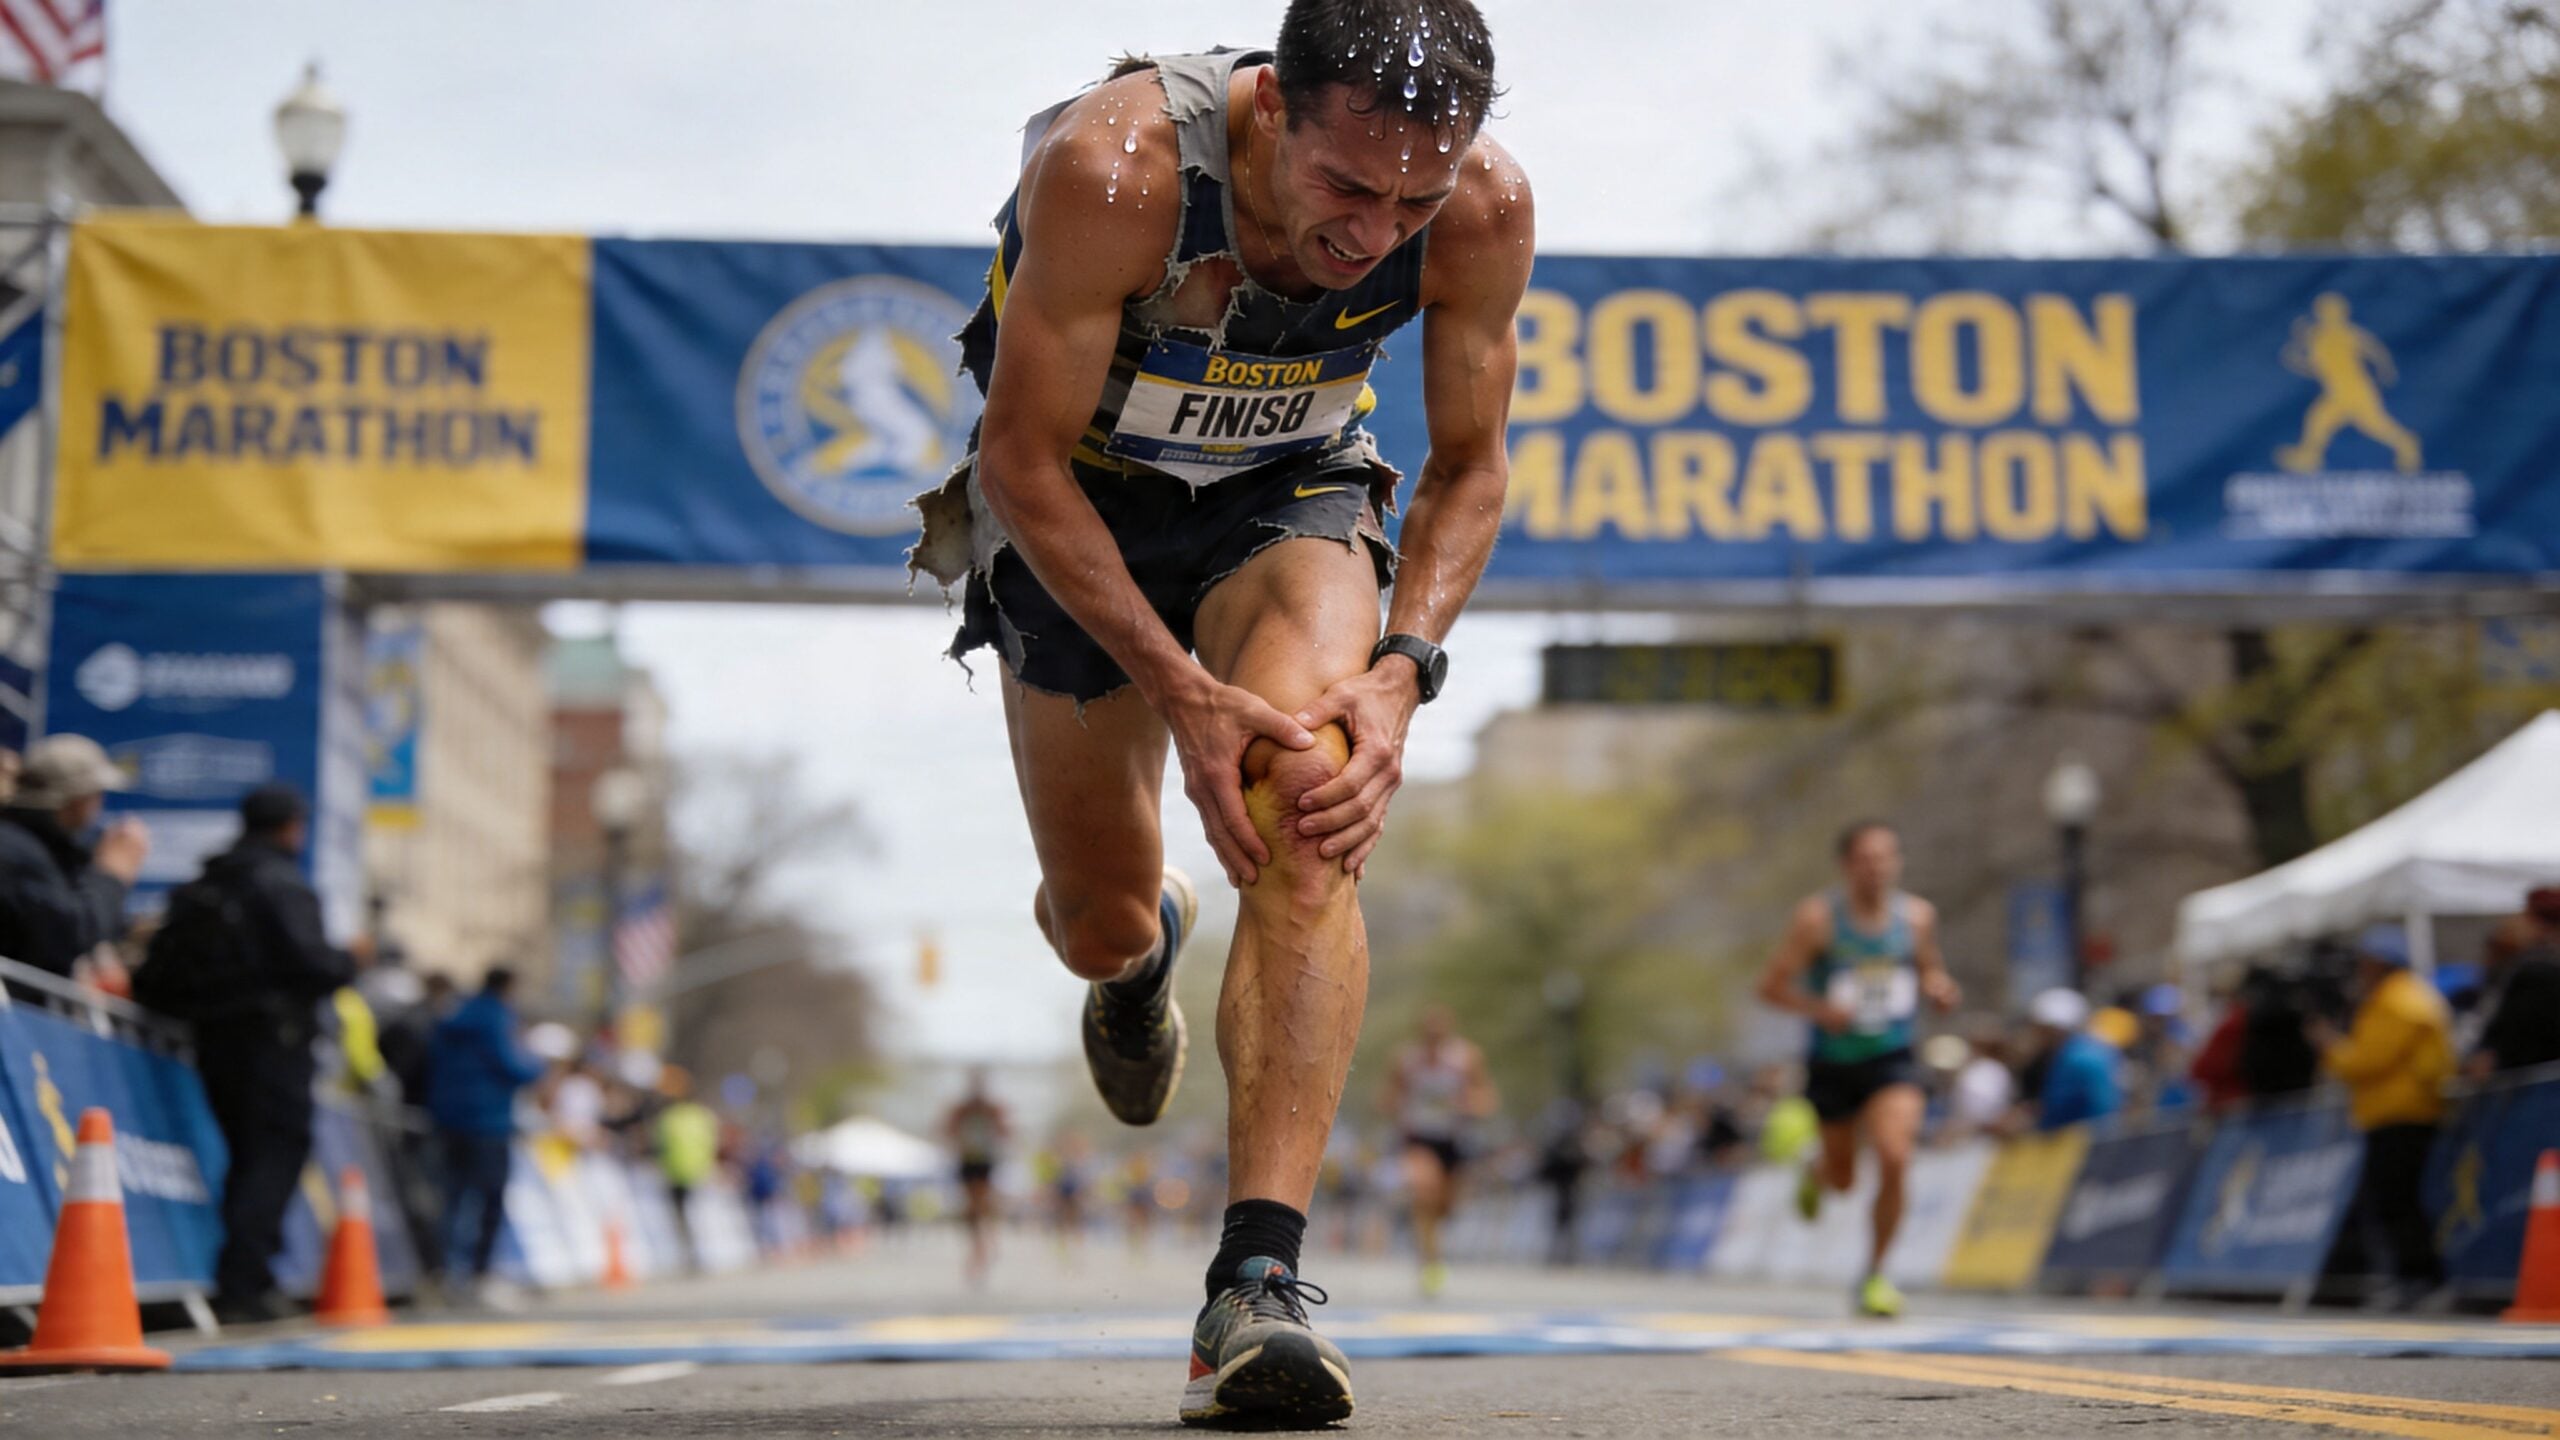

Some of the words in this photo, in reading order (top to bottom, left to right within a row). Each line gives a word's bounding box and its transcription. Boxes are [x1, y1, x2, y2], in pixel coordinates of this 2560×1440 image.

[156, 322, 489, 391] BOSTON
[1202, 354, 1324, 388] BOSTON
[1507, 288, 2139, 425] BOSTON
[97, 393, 541, 468] MARATHON
